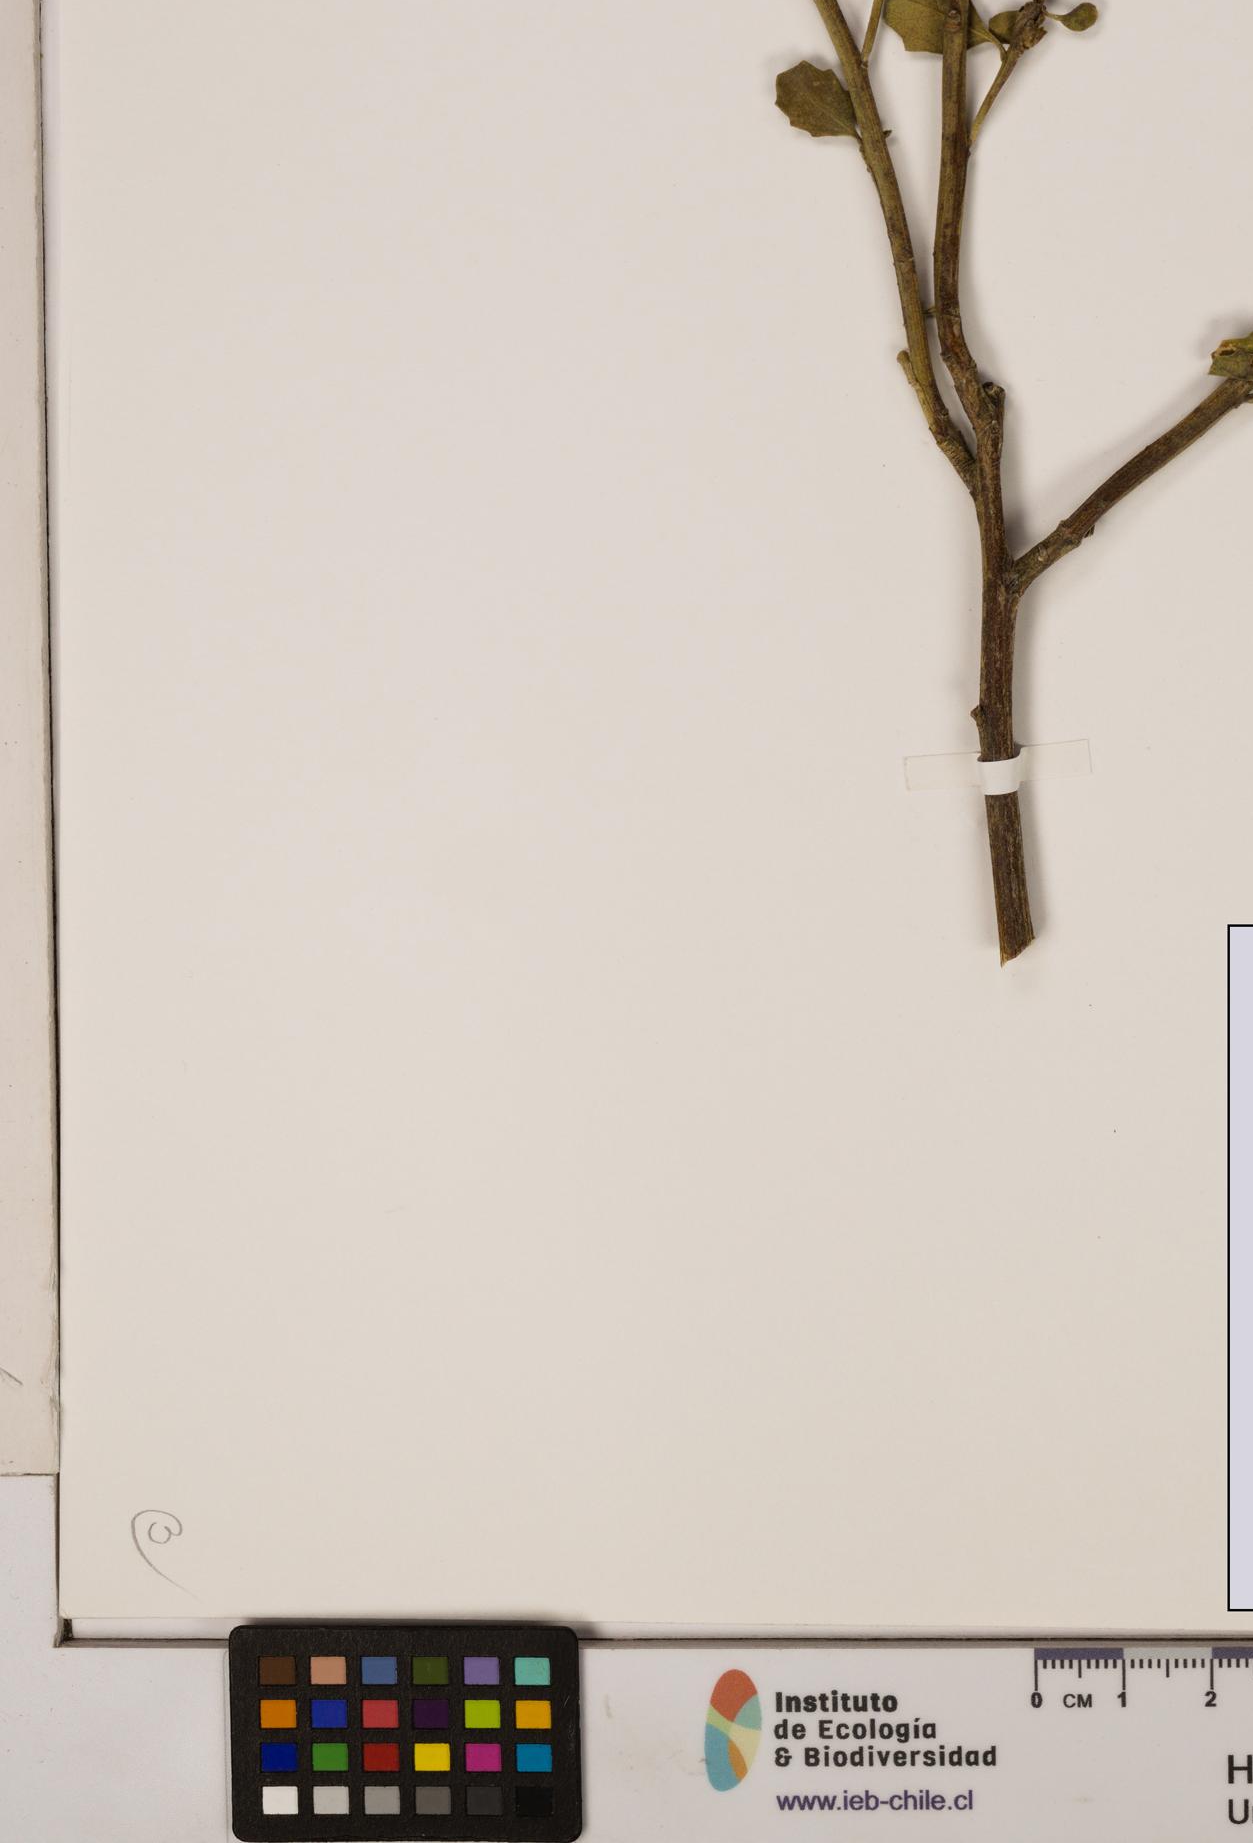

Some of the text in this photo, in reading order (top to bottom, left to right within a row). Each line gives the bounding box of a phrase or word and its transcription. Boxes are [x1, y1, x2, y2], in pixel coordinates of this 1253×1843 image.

[775, 1689, 899, 1713] Instituto
[1030, 1691, 1044, 1709] 0
[1062, 1693, 1093, 1709] CM
[1116, 1691, 1127, 1708] 1
[1204, 1690, 1217, 1708] 2
[773, 1717, 938, 1743] de Ecología
[774, 1744, 998, 1768] & Biodiversidad
[775, 1789, 974, 1812] www.ieb-chile.cl
